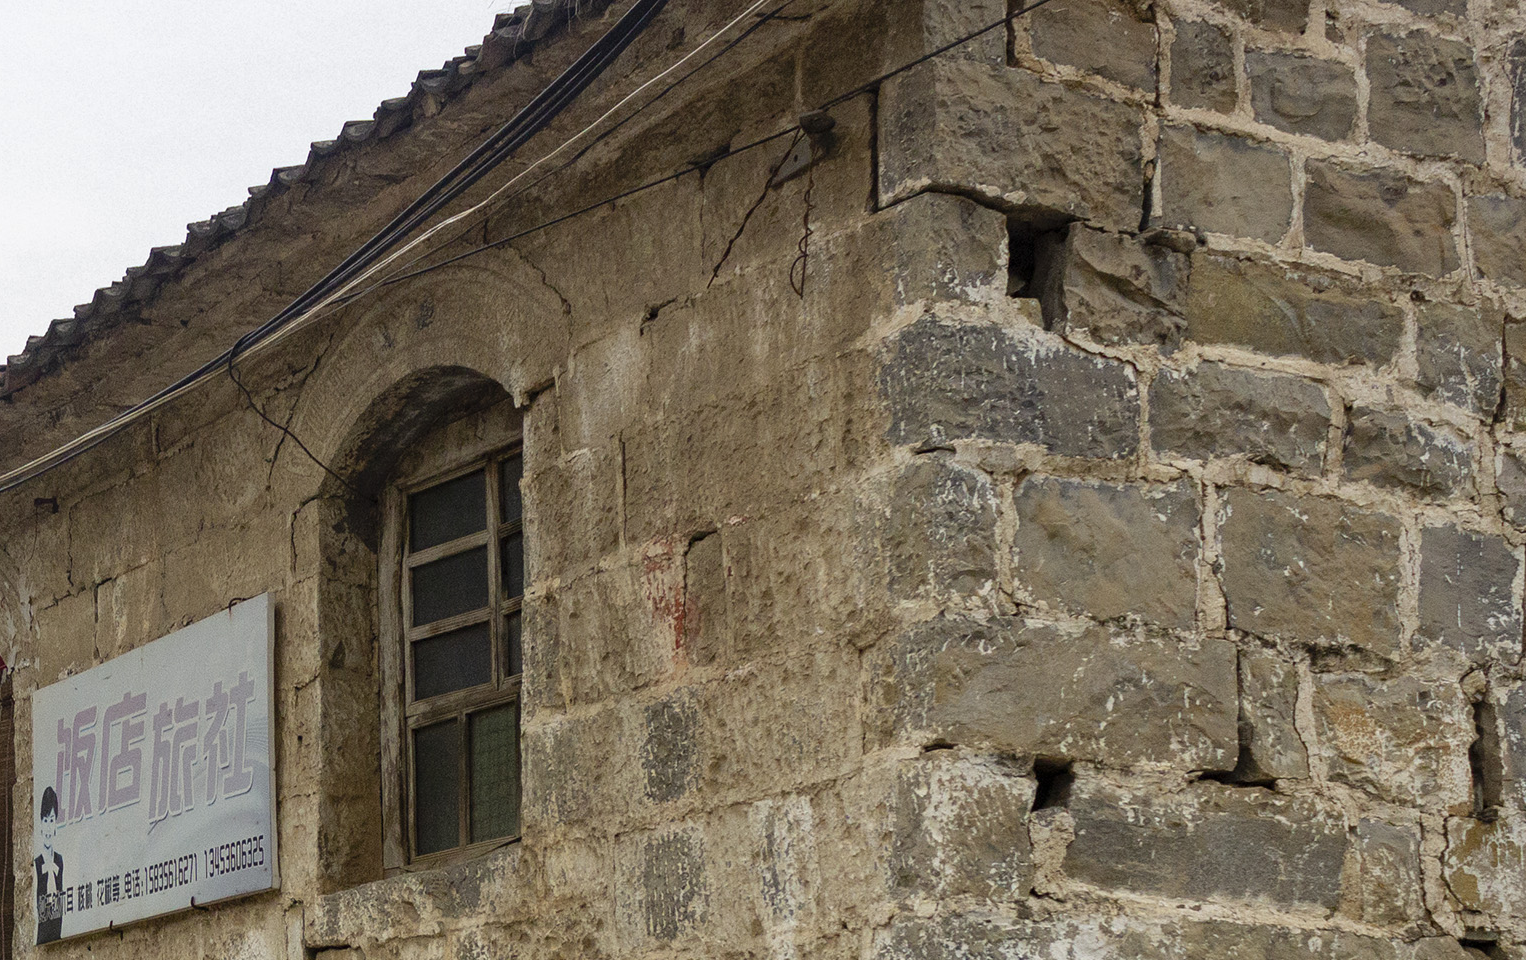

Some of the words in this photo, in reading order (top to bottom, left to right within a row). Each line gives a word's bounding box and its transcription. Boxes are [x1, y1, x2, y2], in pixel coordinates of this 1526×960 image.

[56, 671, 255, 826] 饭店旅社
[204, 835, 264, 879] 13453606325
